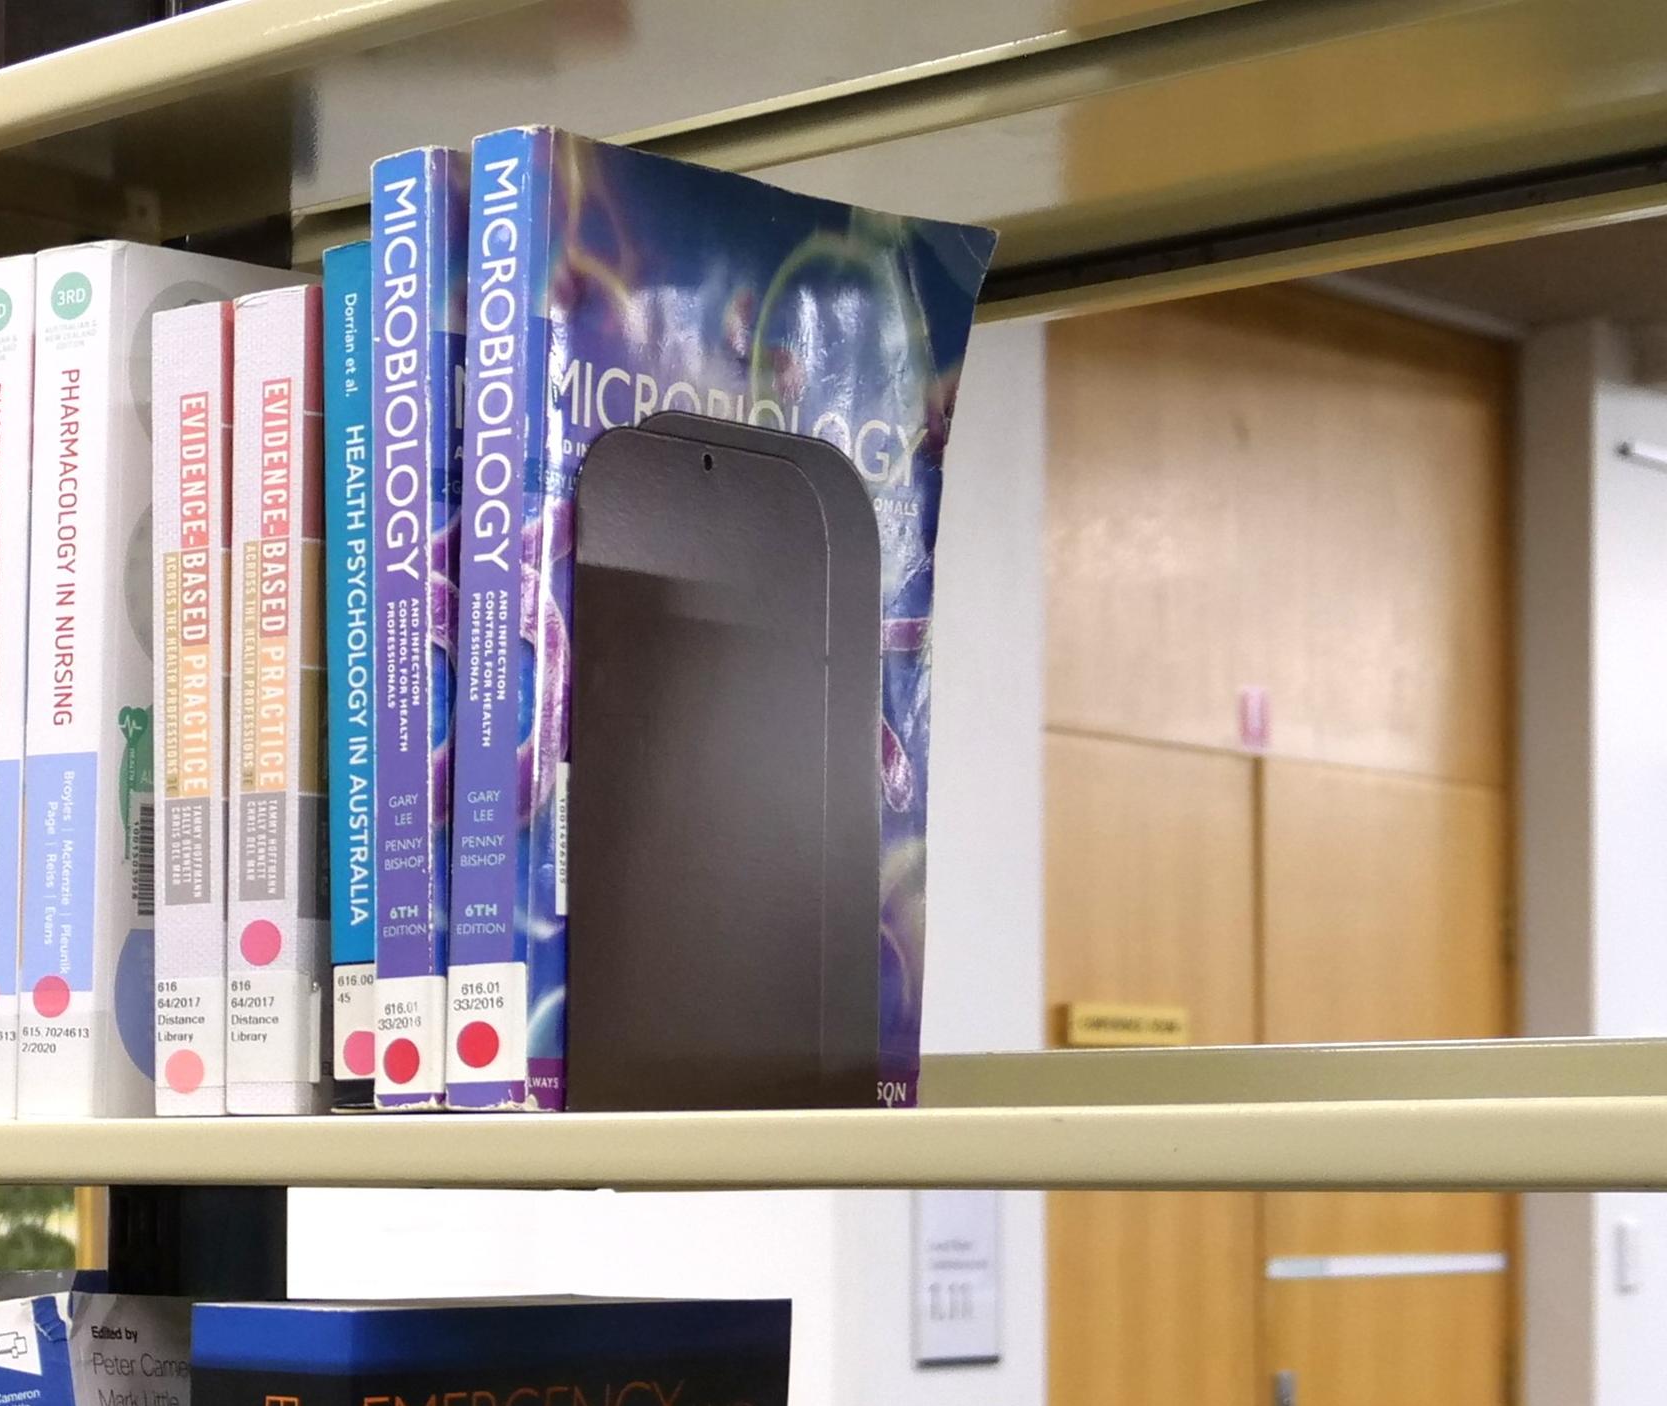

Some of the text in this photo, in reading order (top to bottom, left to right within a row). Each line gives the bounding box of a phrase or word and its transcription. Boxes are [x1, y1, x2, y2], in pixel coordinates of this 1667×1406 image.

[472, 156, 520, 574] MICROBIOLOGY
[383, 175, 420, 580] MICROBIOLOGY
[181, 395, 208, 793] EVIDENCE-BASED PRACTICE
[344, 292, 369, 927] Dorrian HEALTH PSYCHOLOGY IN AUSTRALIA
[467, 789, 501, 805] GARY
[472, 808, 494, 823] LEE
[461, 834, 505, 850] PENNY
[460, 852, 506, 868] BISHOP
[465, 903, 498, 918] 6TH
[456, 922, 506, 937] EDITION
[157, 981, 178, 992] 616
[461, 981, 501, 996] 616.01
[157, 996, 201, 1009] 64/2017
[453, 996, 504, 1013] 33/2016
[157, 1013, 205, 1025] Distance
[157, 1030, 194, 1044] Library
